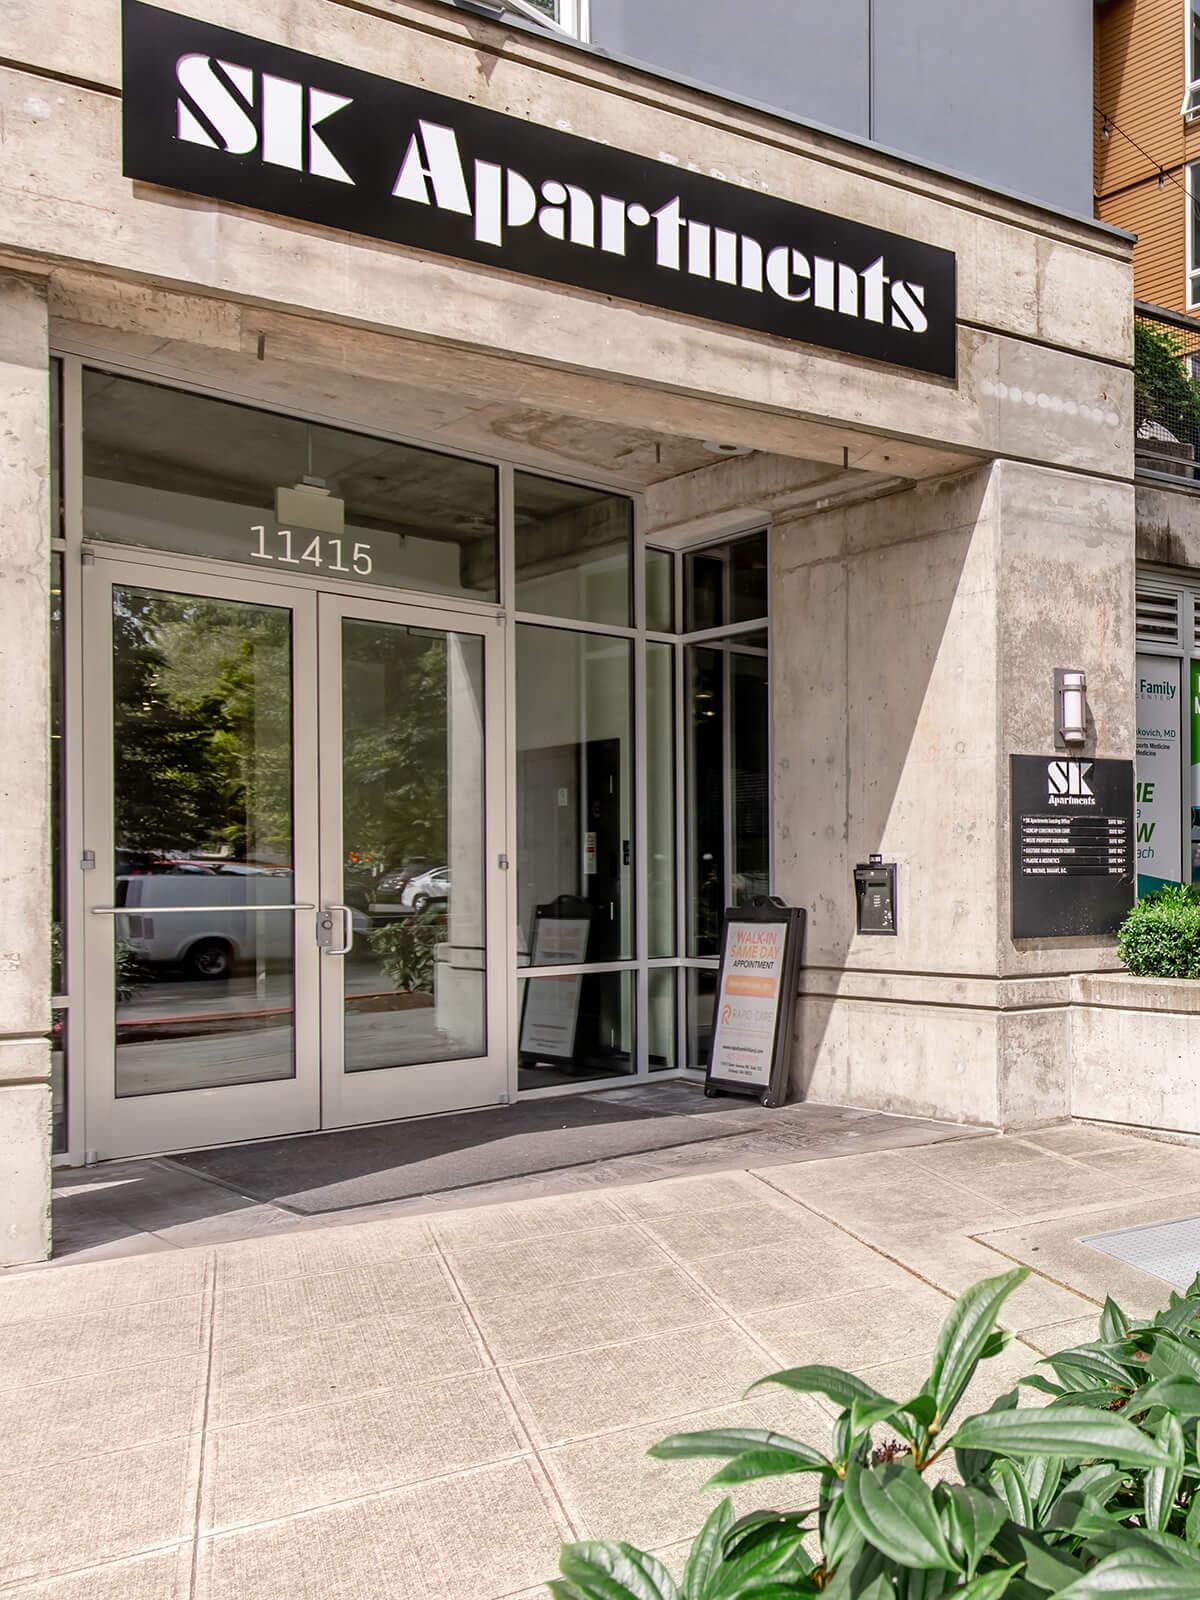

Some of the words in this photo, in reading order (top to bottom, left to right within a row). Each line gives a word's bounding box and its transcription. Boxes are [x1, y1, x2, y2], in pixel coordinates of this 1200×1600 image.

[173, 52, 356, 186] SK
[390, 117, 929, 335] Apartments
[250, 525, 374, 577] 11415
[1140, 679, 1176, 699] Family
[1164, 730, 1176, 739] MD
[1047, 761, 1094, 795] SK
[1048, 795, 1095, 806] Apartments
[736, 931, 777, 944] WALK-IN
[730, 945, 759, 959] SAME
[760, 946, 781, 959] DAY
[733, 960, 775, 969] APPOINTMENT
